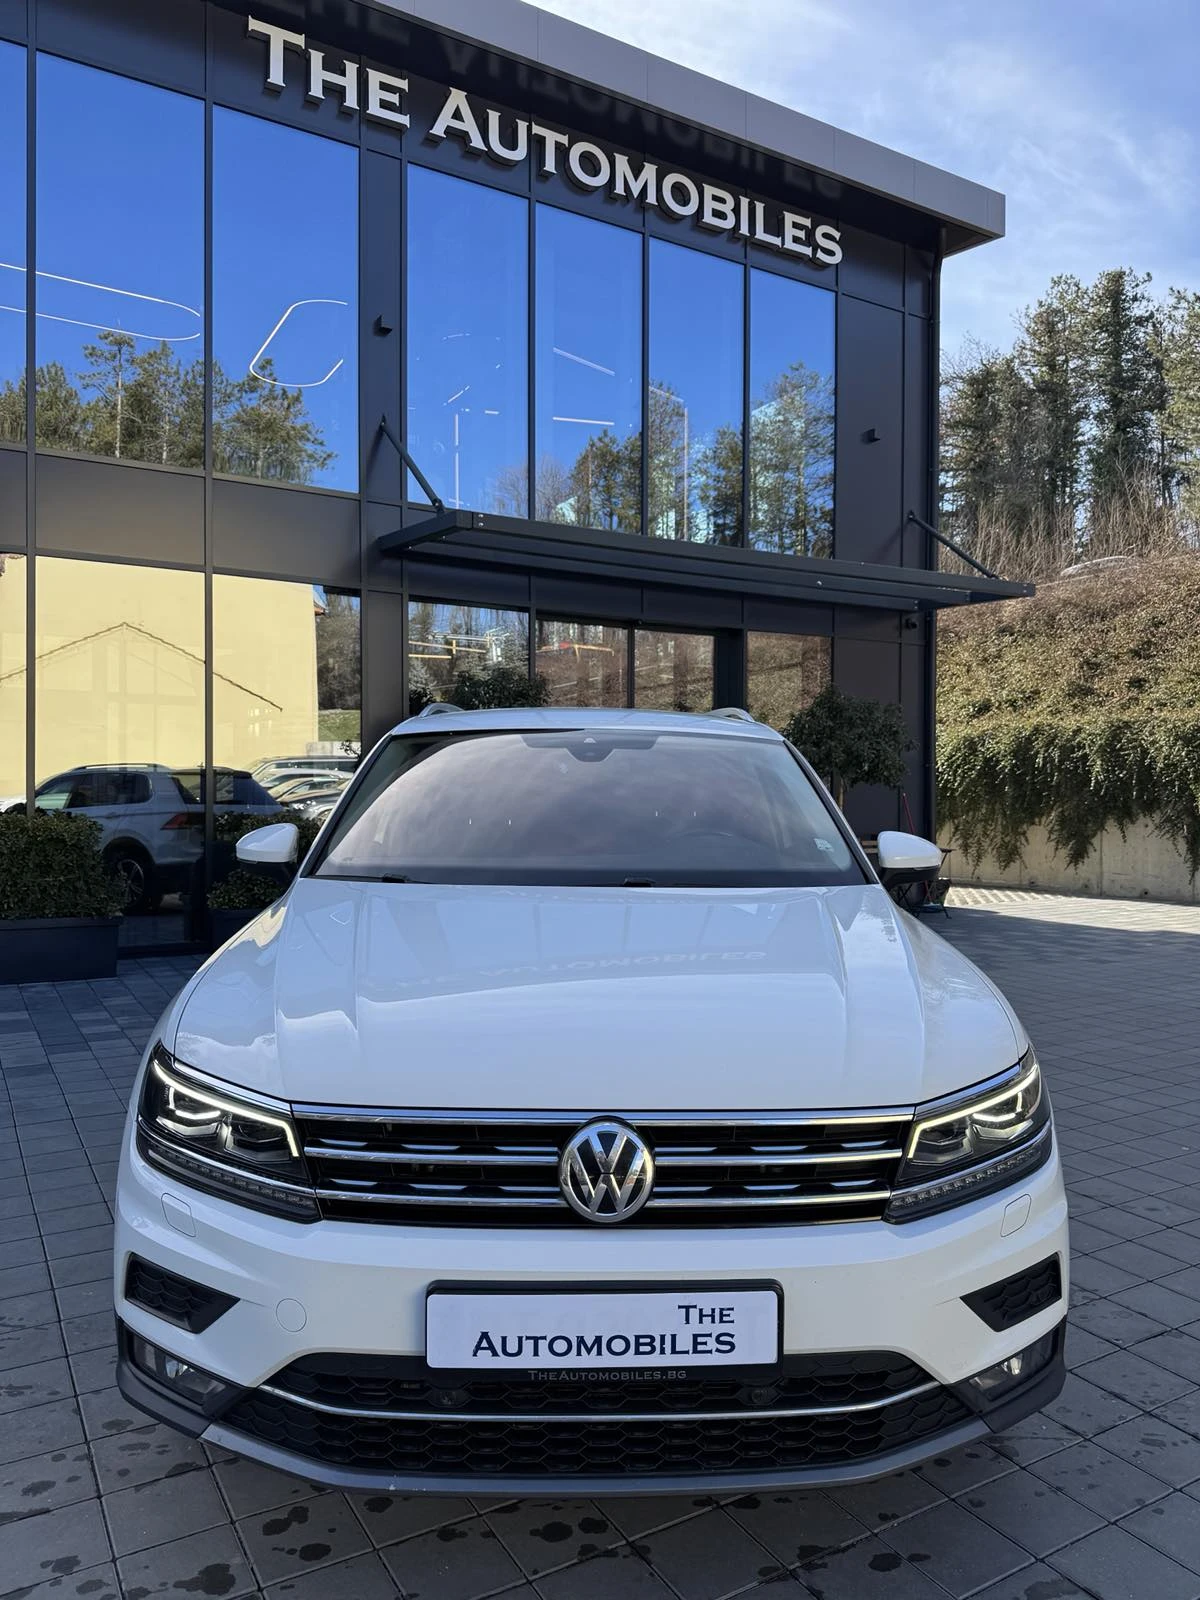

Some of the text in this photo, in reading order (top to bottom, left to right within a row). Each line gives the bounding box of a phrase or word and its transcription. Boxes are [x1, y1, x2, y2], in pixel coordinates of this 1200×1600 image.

[247, 15, 410, 130] THE
[428, 88, 843, 266] AUTOMOBILES
[677, 1304, 735, 1325] THE
[471, 1331, 736, 1358] AUTOMOBILES
